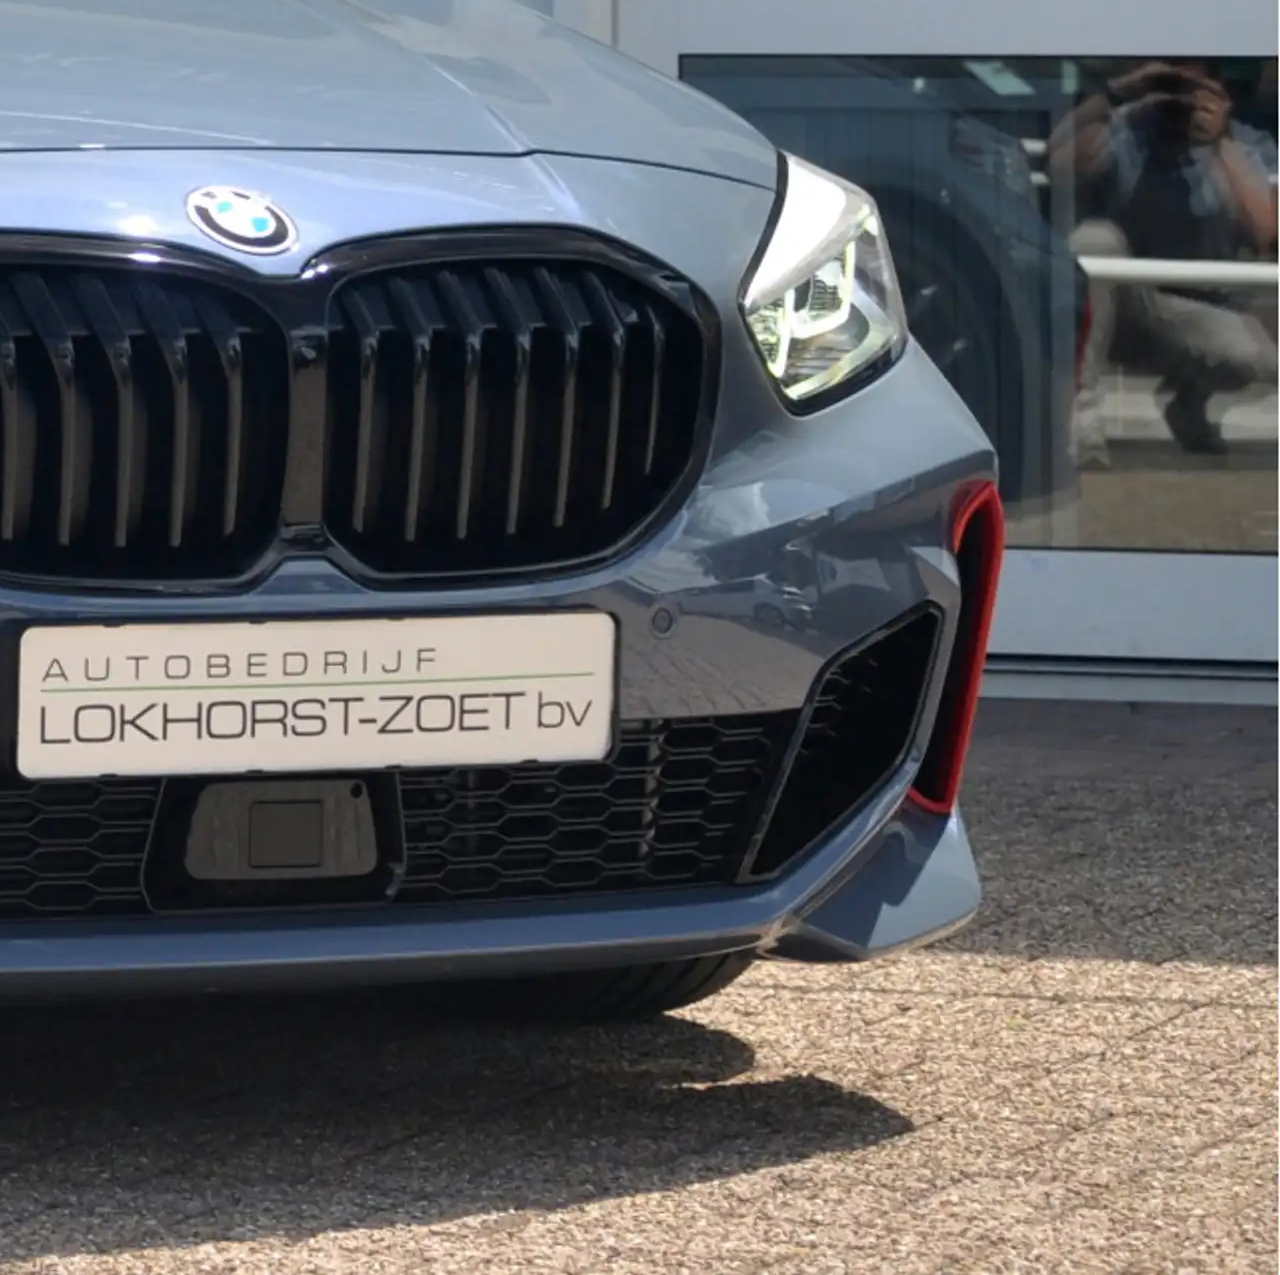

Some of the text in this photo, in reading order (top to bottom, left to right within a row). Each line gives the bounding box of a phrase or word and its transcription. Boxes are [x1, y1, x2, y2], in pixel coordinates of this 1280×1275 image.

[41, 647, 437, 682] AUTOBEDRIJF
[40, 691, 593, 744] LOKHORST-ZOET bv
